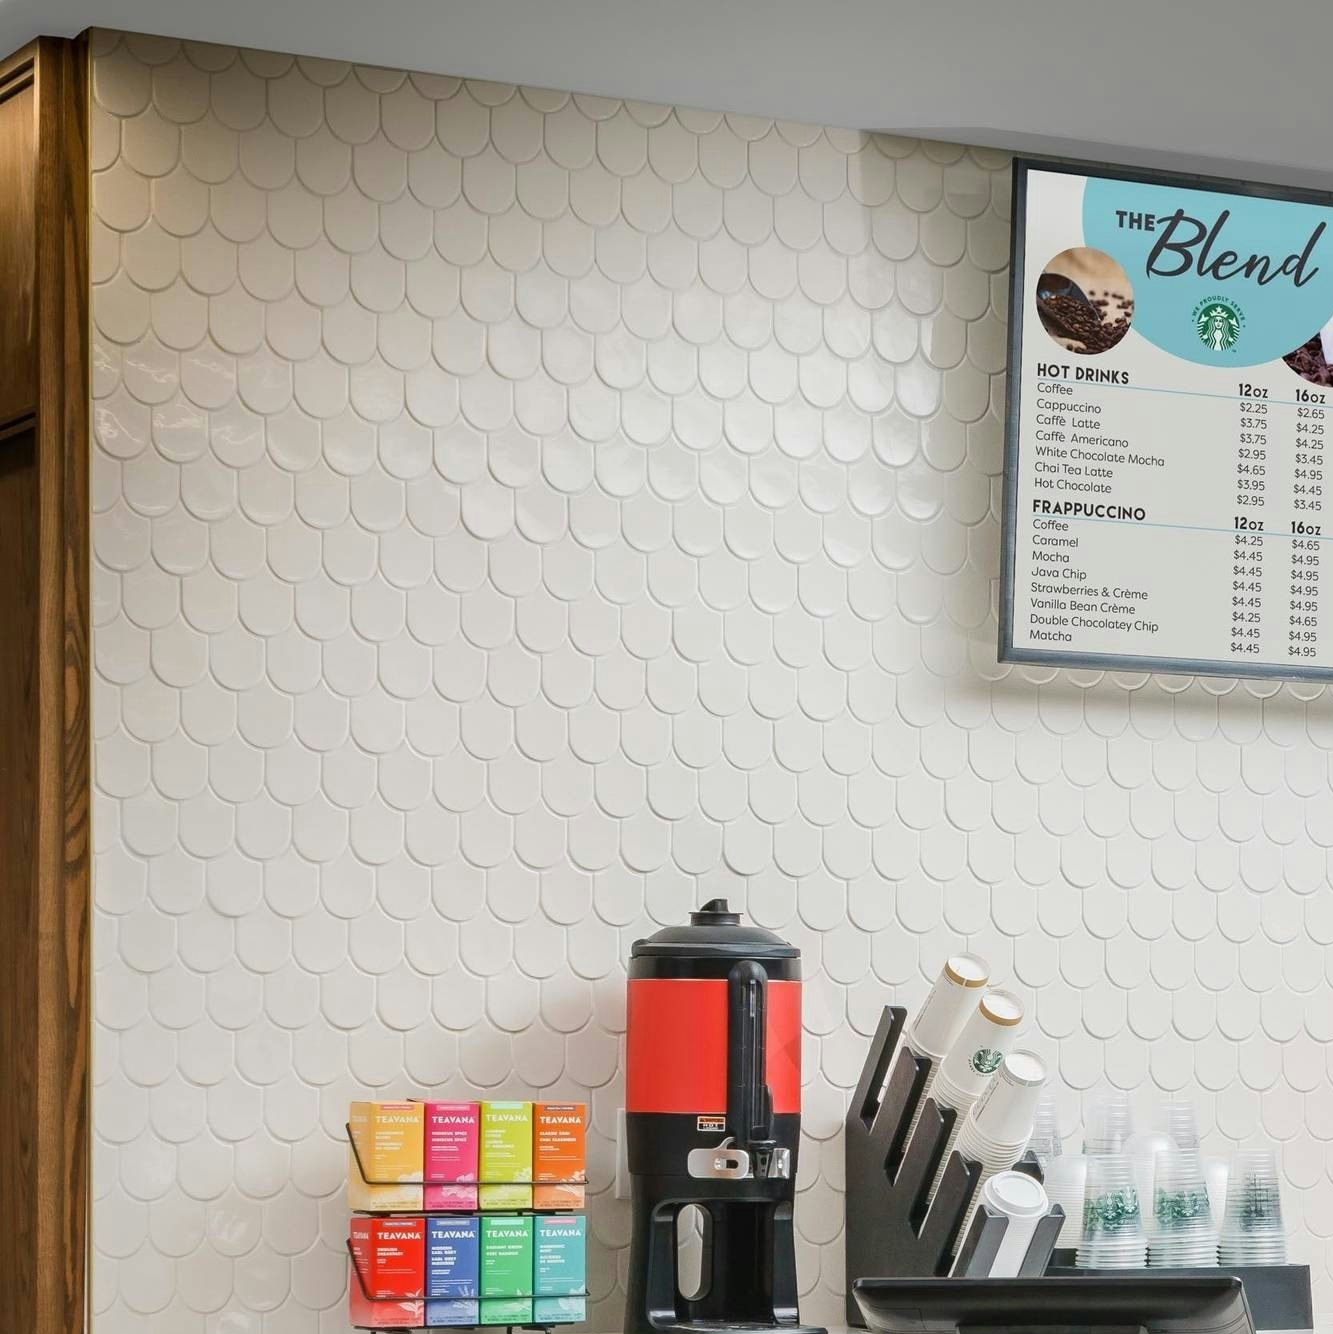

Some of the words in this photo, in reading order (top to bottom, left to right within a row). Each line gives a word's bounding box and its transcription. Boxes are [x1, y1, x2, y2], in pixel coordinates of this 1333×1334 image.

[1116, 210, 1156, 232] THE
[1146, 208, 1327, 288] Blend
[1200, 295, 1229, 306] PROUDLY
[1037, 362, 1070, 379] HOT
[1075, 366, 1129, 385] DRINKS
[1037, 382, 1073, 395] Coffee
[1238, 383, 1268, 399] 12oz
[1295, 388, 1325, 404] 16oz
[1036, 398, 1102, 414] Cappuccino
[1239, 401, 1268, 414] $2.25
[1296, 407, 1325, 419] $2.65
[1036, 413, 1066, 426] Caffè
[1072, 417, 1100, 430] Latte
[1035, 429, 1065, 442] Caffè
[1070, 433, 1129, 448] Americano
[1035, 445, 1067, 458] White
[1069, 448, 1125, 463] Chocolate
[1127, 453, 1164, 467] Mocha
[1034, 461, 1059, 473] Chai
[1061, 463, 1081, 475] Tea
[1084, 466, 1113, 478] Latte
[1236, 462, 1266, 476] $4.65
[1294, 467, 1323, 480] $4.95
[1034, 477, 1054, 489] Hot
[1056, 479, 1112, 493] Chocolate
[1032, 499, 1146, 521] FRAPPUCCINO
[1234, 515, 1264, 531] 12oz
[1290, 520, 1321, 536] 16oz
[1032, 534, 1079, 547] Caramel
[1234, 534, 1263, 547] $4.25
[1291, 539, 1320, 551] $4.65
[1031, 566, 1059, 578] Java
[1062, 568, 1087, 582] Chip
[1030, 597, 1066, 610] Vanilla
[1070, 600, 1097, 612] Bean
[1100, 602, 1135, 615] Crème
[1029, 629, 1072, 642] Matcha
[376, 1115, 420, 1124] TEAVANA
[432, 1116, 475, 1124] TEAVANA
[540, 1116, 581, 1124] TEAVANA
[377, 1231, 422, 1240] TEAVANA
[431, 1230, 475, 1239] TEAVANA
[486, 1230, 529, 1238] TEAVANA
[540, 1229, 581, 1237] TEAVANA
